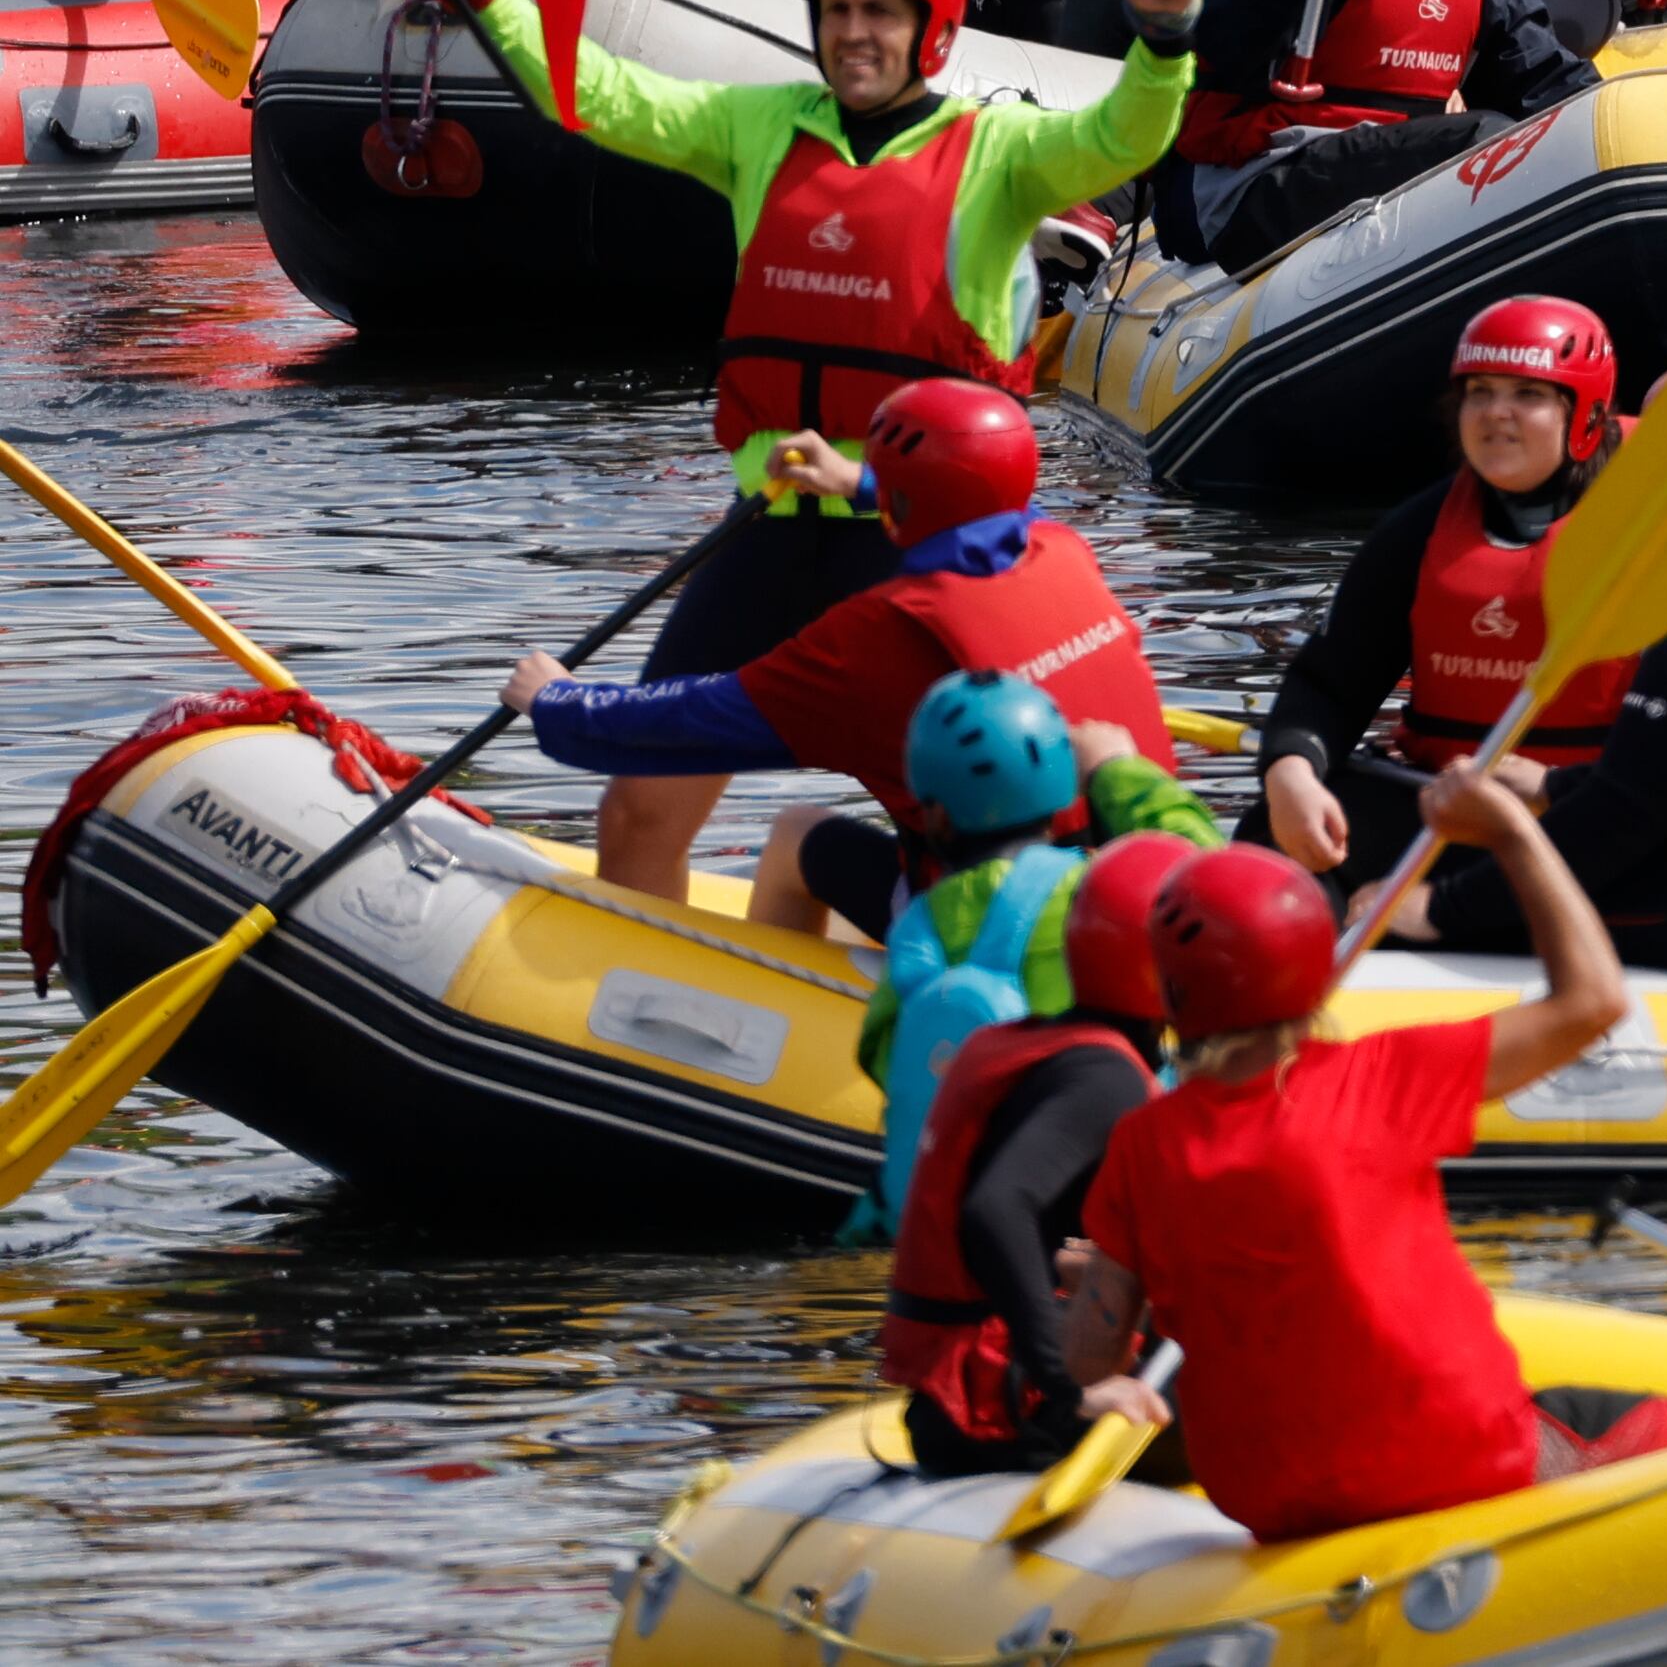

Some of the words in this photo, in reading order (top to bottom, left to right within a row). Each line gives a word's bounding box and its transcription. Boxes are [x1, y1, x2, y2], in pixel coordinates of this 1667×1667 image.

[1379, 46, 1462, 72] TURNAUGA
[763, 265, 892, 301] TURNAUGA
[1458, 342, 1554, 371] TURNAUGA
[1017, 615, 1128, 685] TURNAUGA
[1431, 652, 1538, 681] TURNAU
[171, 788, 304, 879] AVANTI
